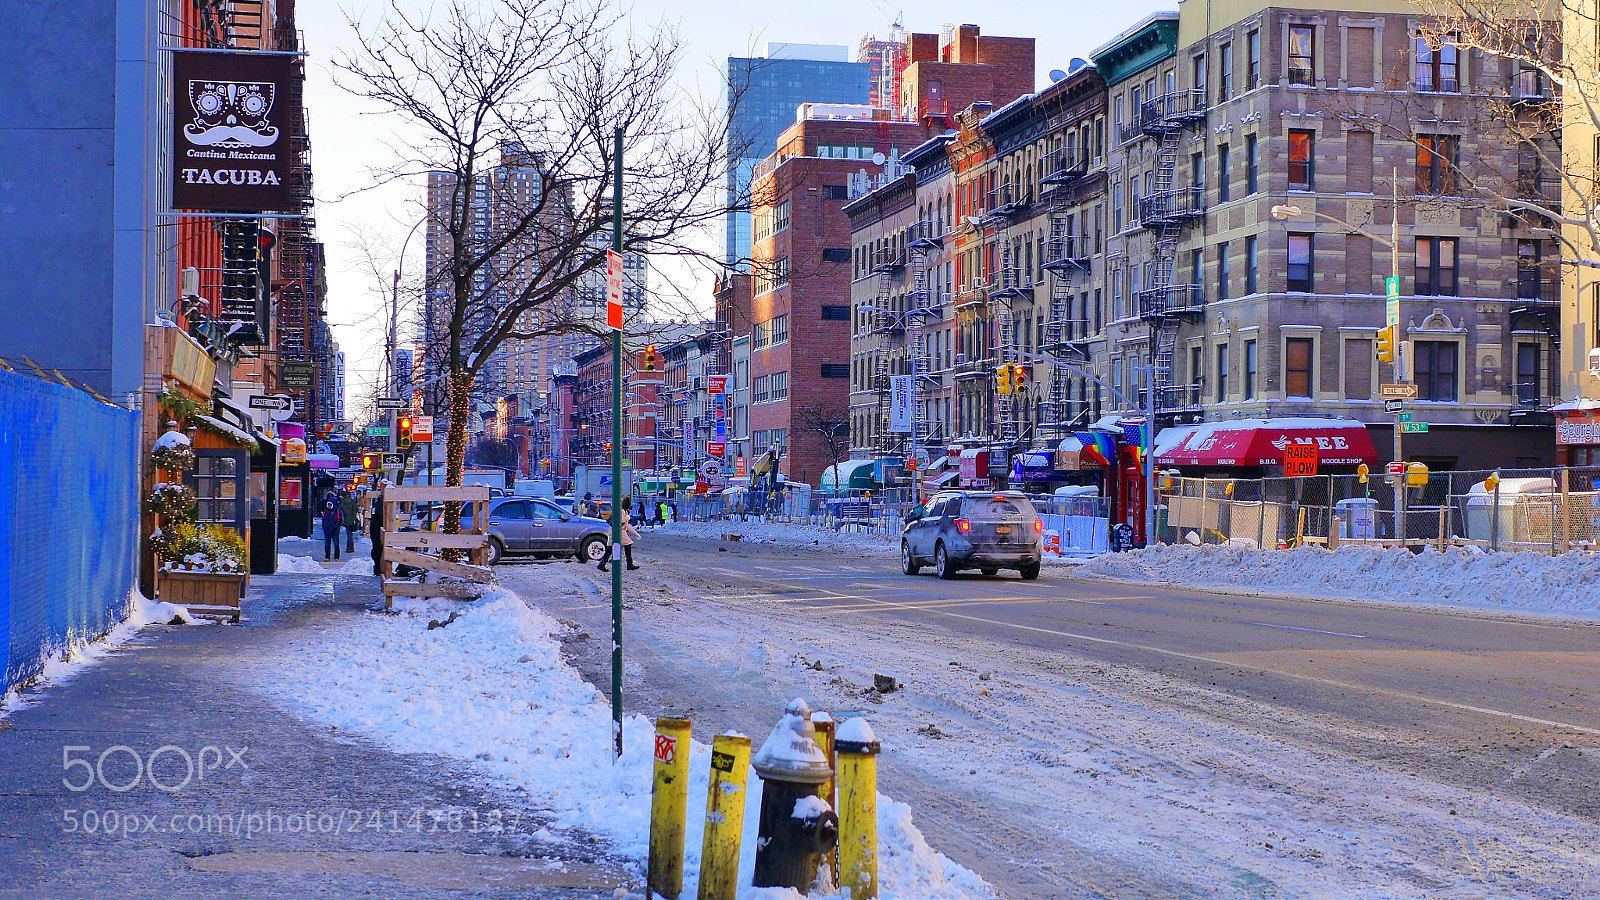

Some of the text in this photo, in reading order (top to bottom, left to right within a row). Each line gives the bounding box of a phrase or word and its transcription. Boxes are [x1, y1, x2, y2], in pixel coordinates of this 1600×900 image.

[187, 149, 276, 160] Cantina Mexicana
[182, 168, 280, 185] TACUBA
[1287, 447, 1315, 459] RAISE
[1286, 462, 1314, 474] PLOW
